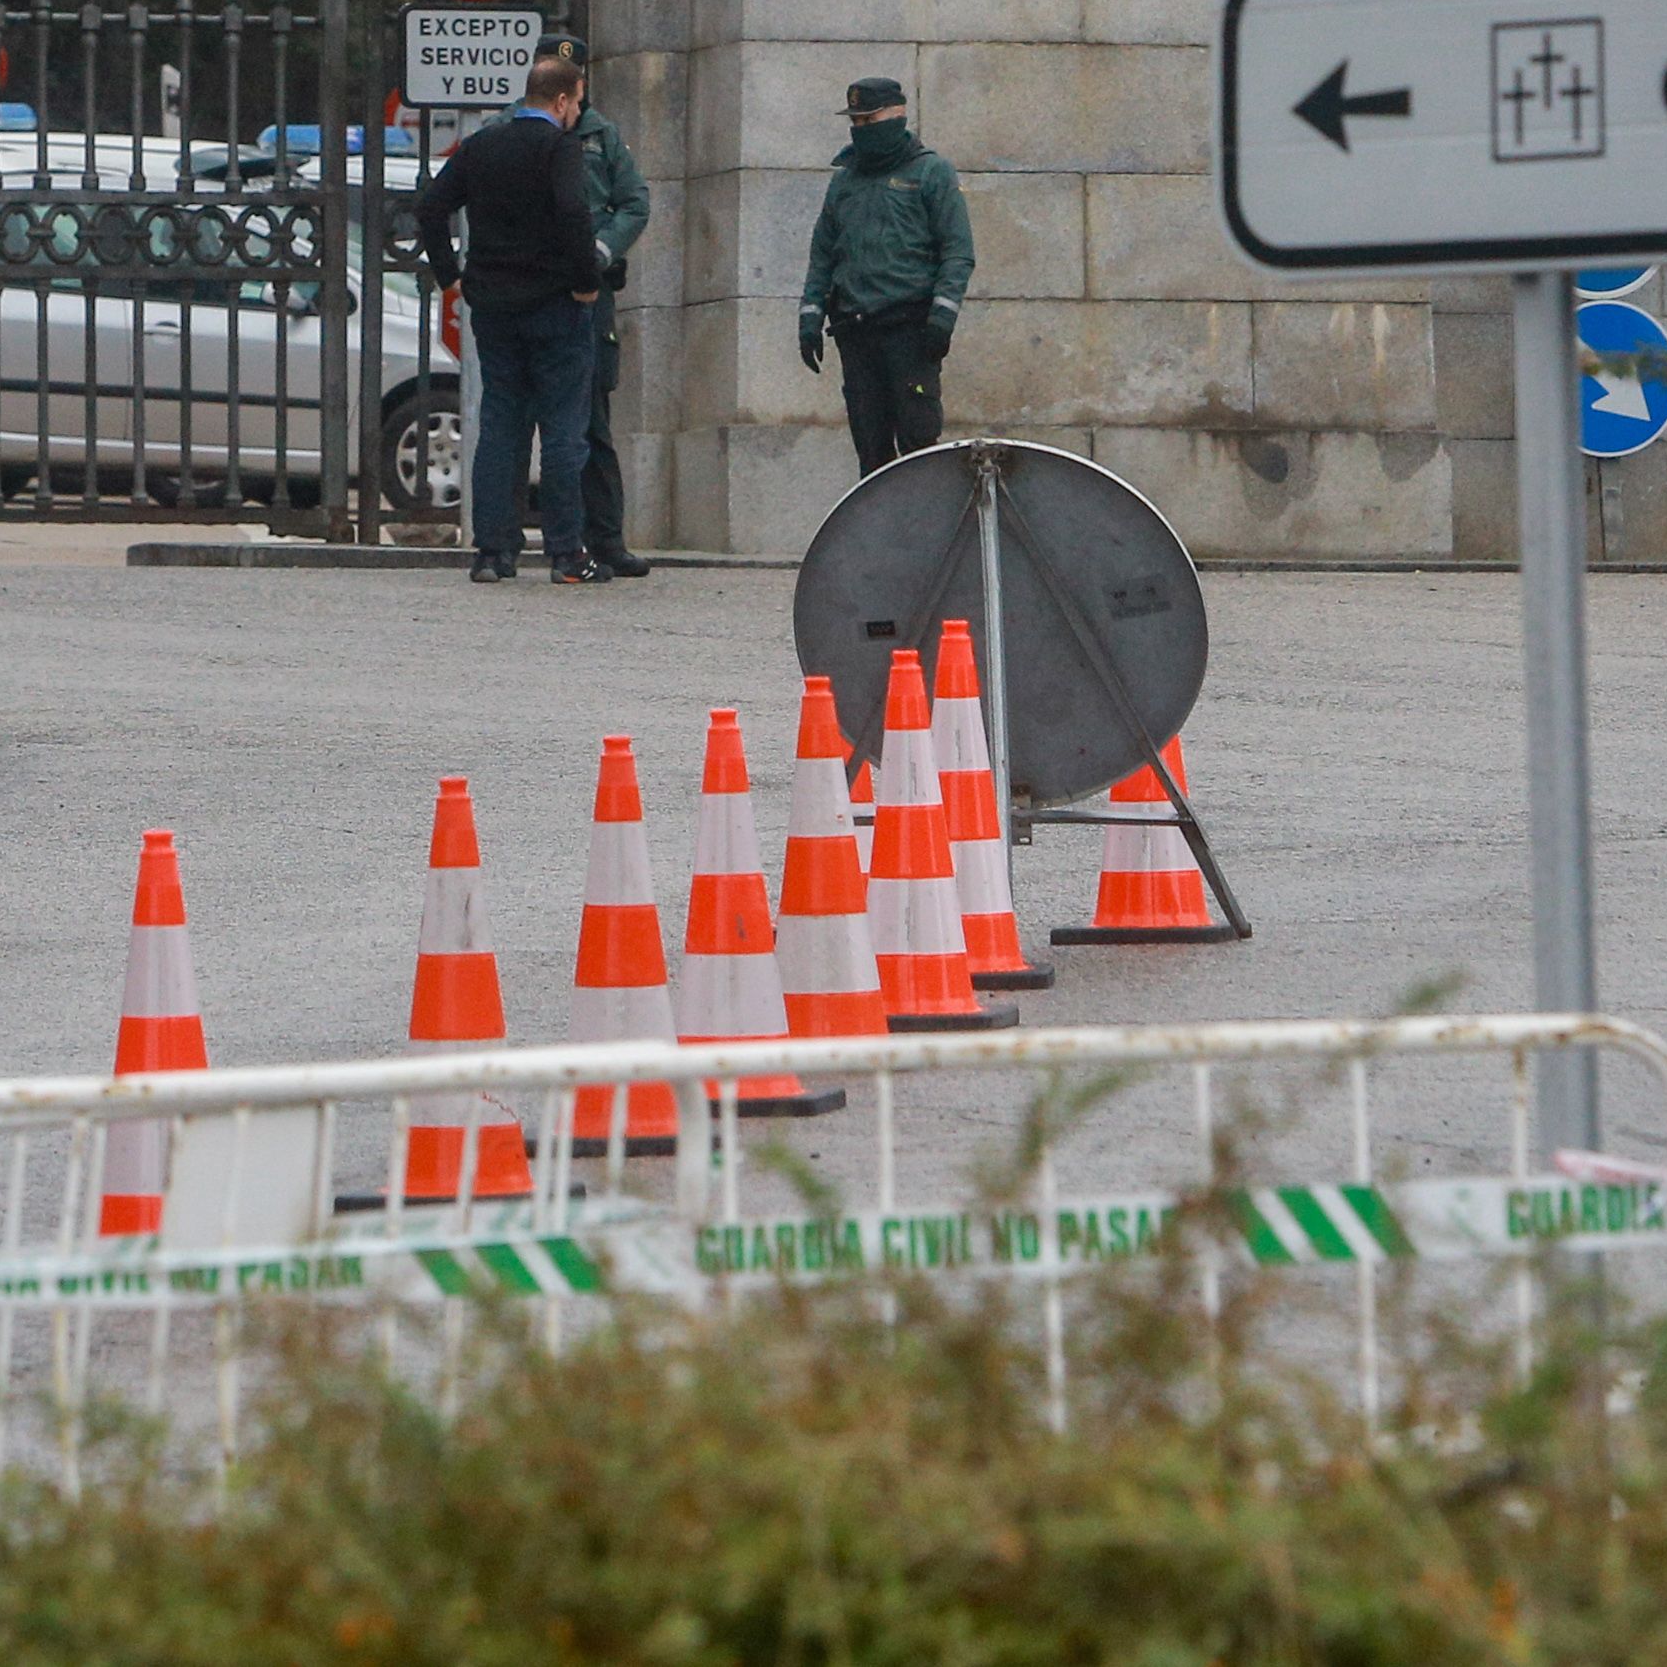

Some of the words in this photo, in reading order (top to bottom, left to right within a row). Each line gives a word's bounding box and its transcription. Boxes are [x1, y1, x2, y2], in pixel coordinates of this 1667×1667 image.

[419, 18, 530, 37] EXCEPTO
[420, 47, 529, 66] SERVICIO
[441, 77, 455, 94] Y
[464, 77, 510, 95] BUS
[695, 1219, 865, 1275] GUARDIA
[879, 1214, 972, 1269] CIVIL
[991, 1210, 1040, 1264] NO
